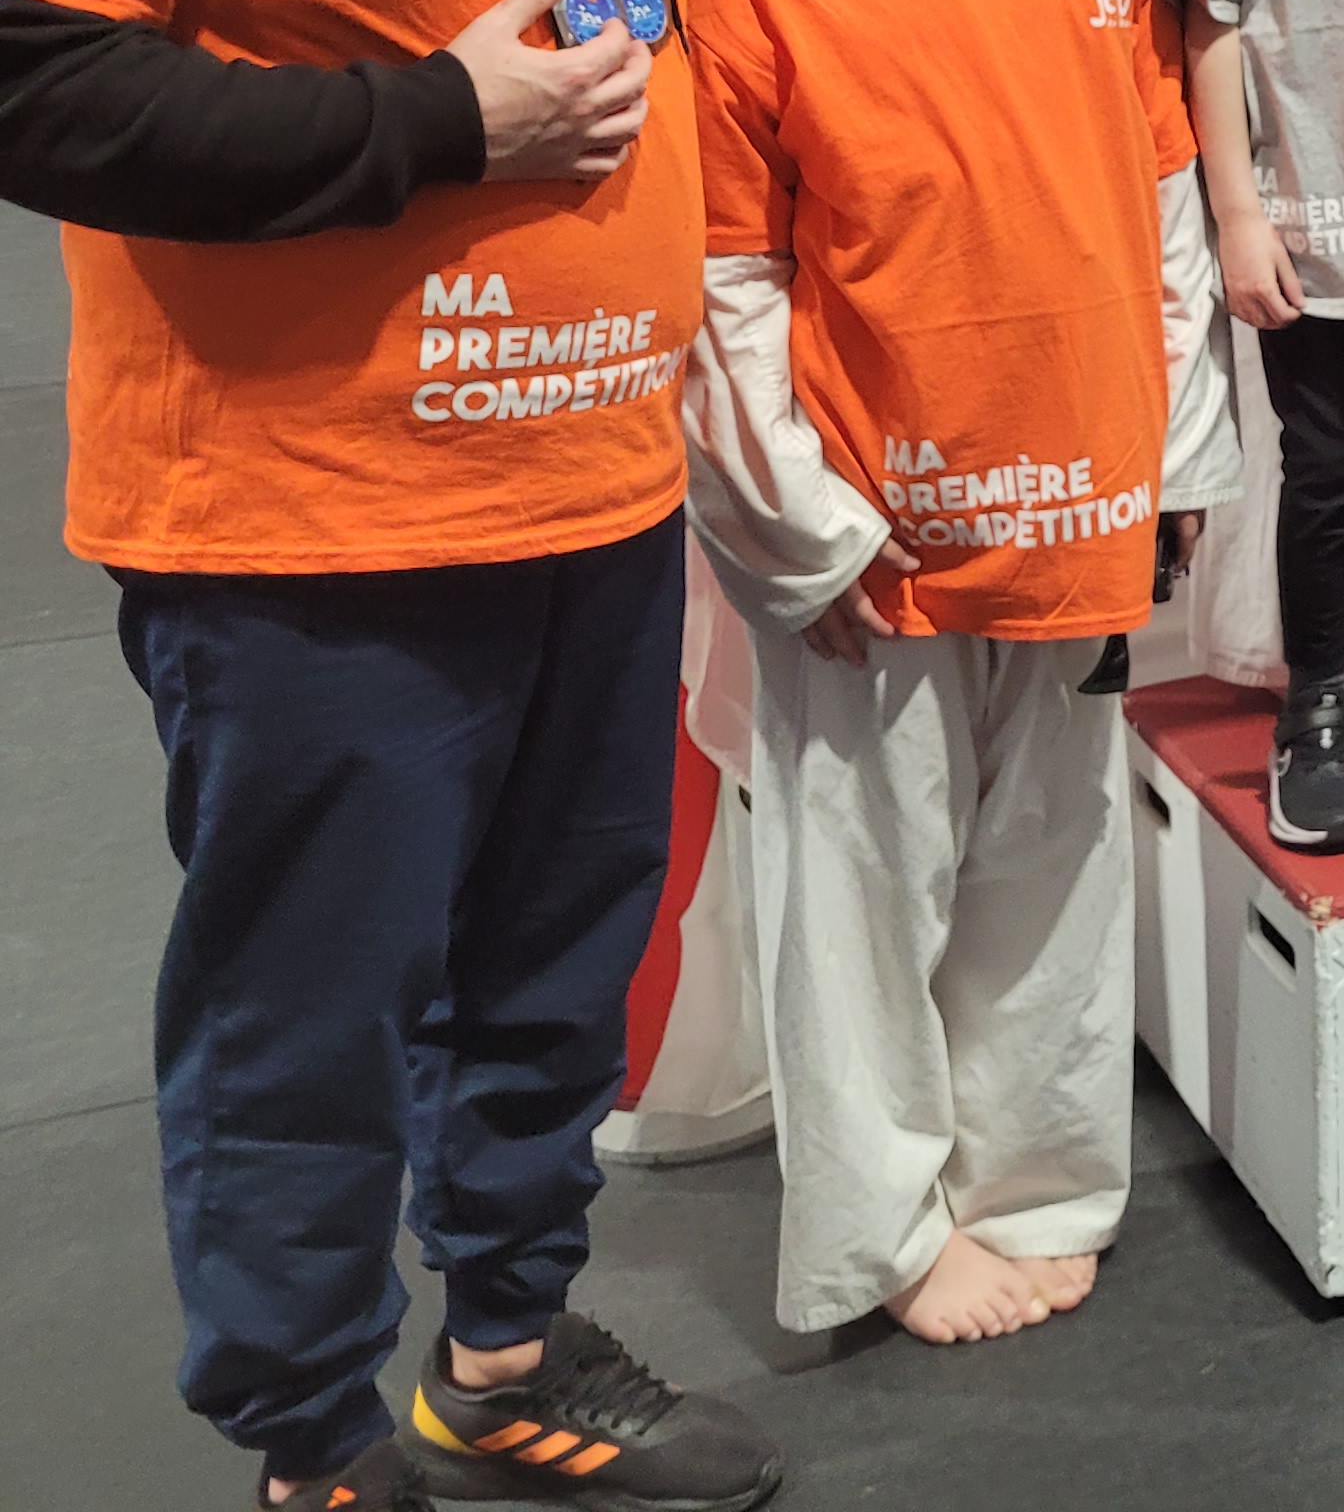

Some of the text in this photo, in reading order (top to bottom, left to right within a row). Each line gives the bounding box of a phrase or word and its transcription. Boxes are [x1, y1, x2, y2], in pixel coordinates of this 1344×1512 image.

[421, 273, 514, 317] MA
[419, 307, 658, 371] PREMIÈRE
[411, 343, 688, 422] COMPÉTITION
[882, 453, 1094, 514] PREMIÈRE
[884, 435, 947, 476] MA
[899, 481, 1152, 549] COMPÉTITION
